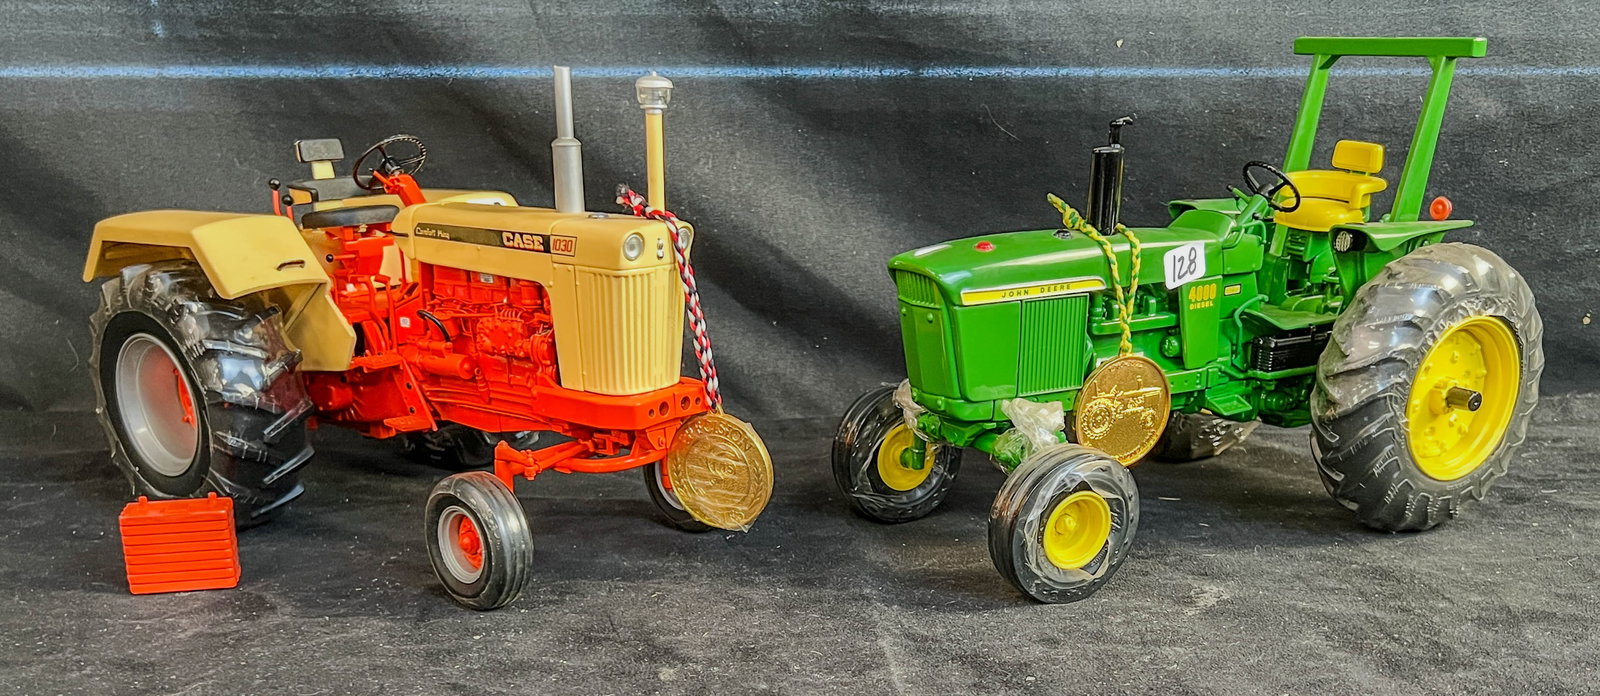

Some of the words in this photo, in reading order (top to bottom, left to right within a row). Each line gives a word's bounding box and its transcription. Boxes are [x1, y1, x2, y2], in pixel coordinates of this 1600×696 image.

[502, 231, 544, 251] CASE
[552, 238, 573, 253] 1030
[1172, 246, 1197, 283] 128
[1002, 289, 1029, 299] JOHN
[1040, 283, 1071, 294] DEERE
[1189, 301, 1214, 311] DIESEL
